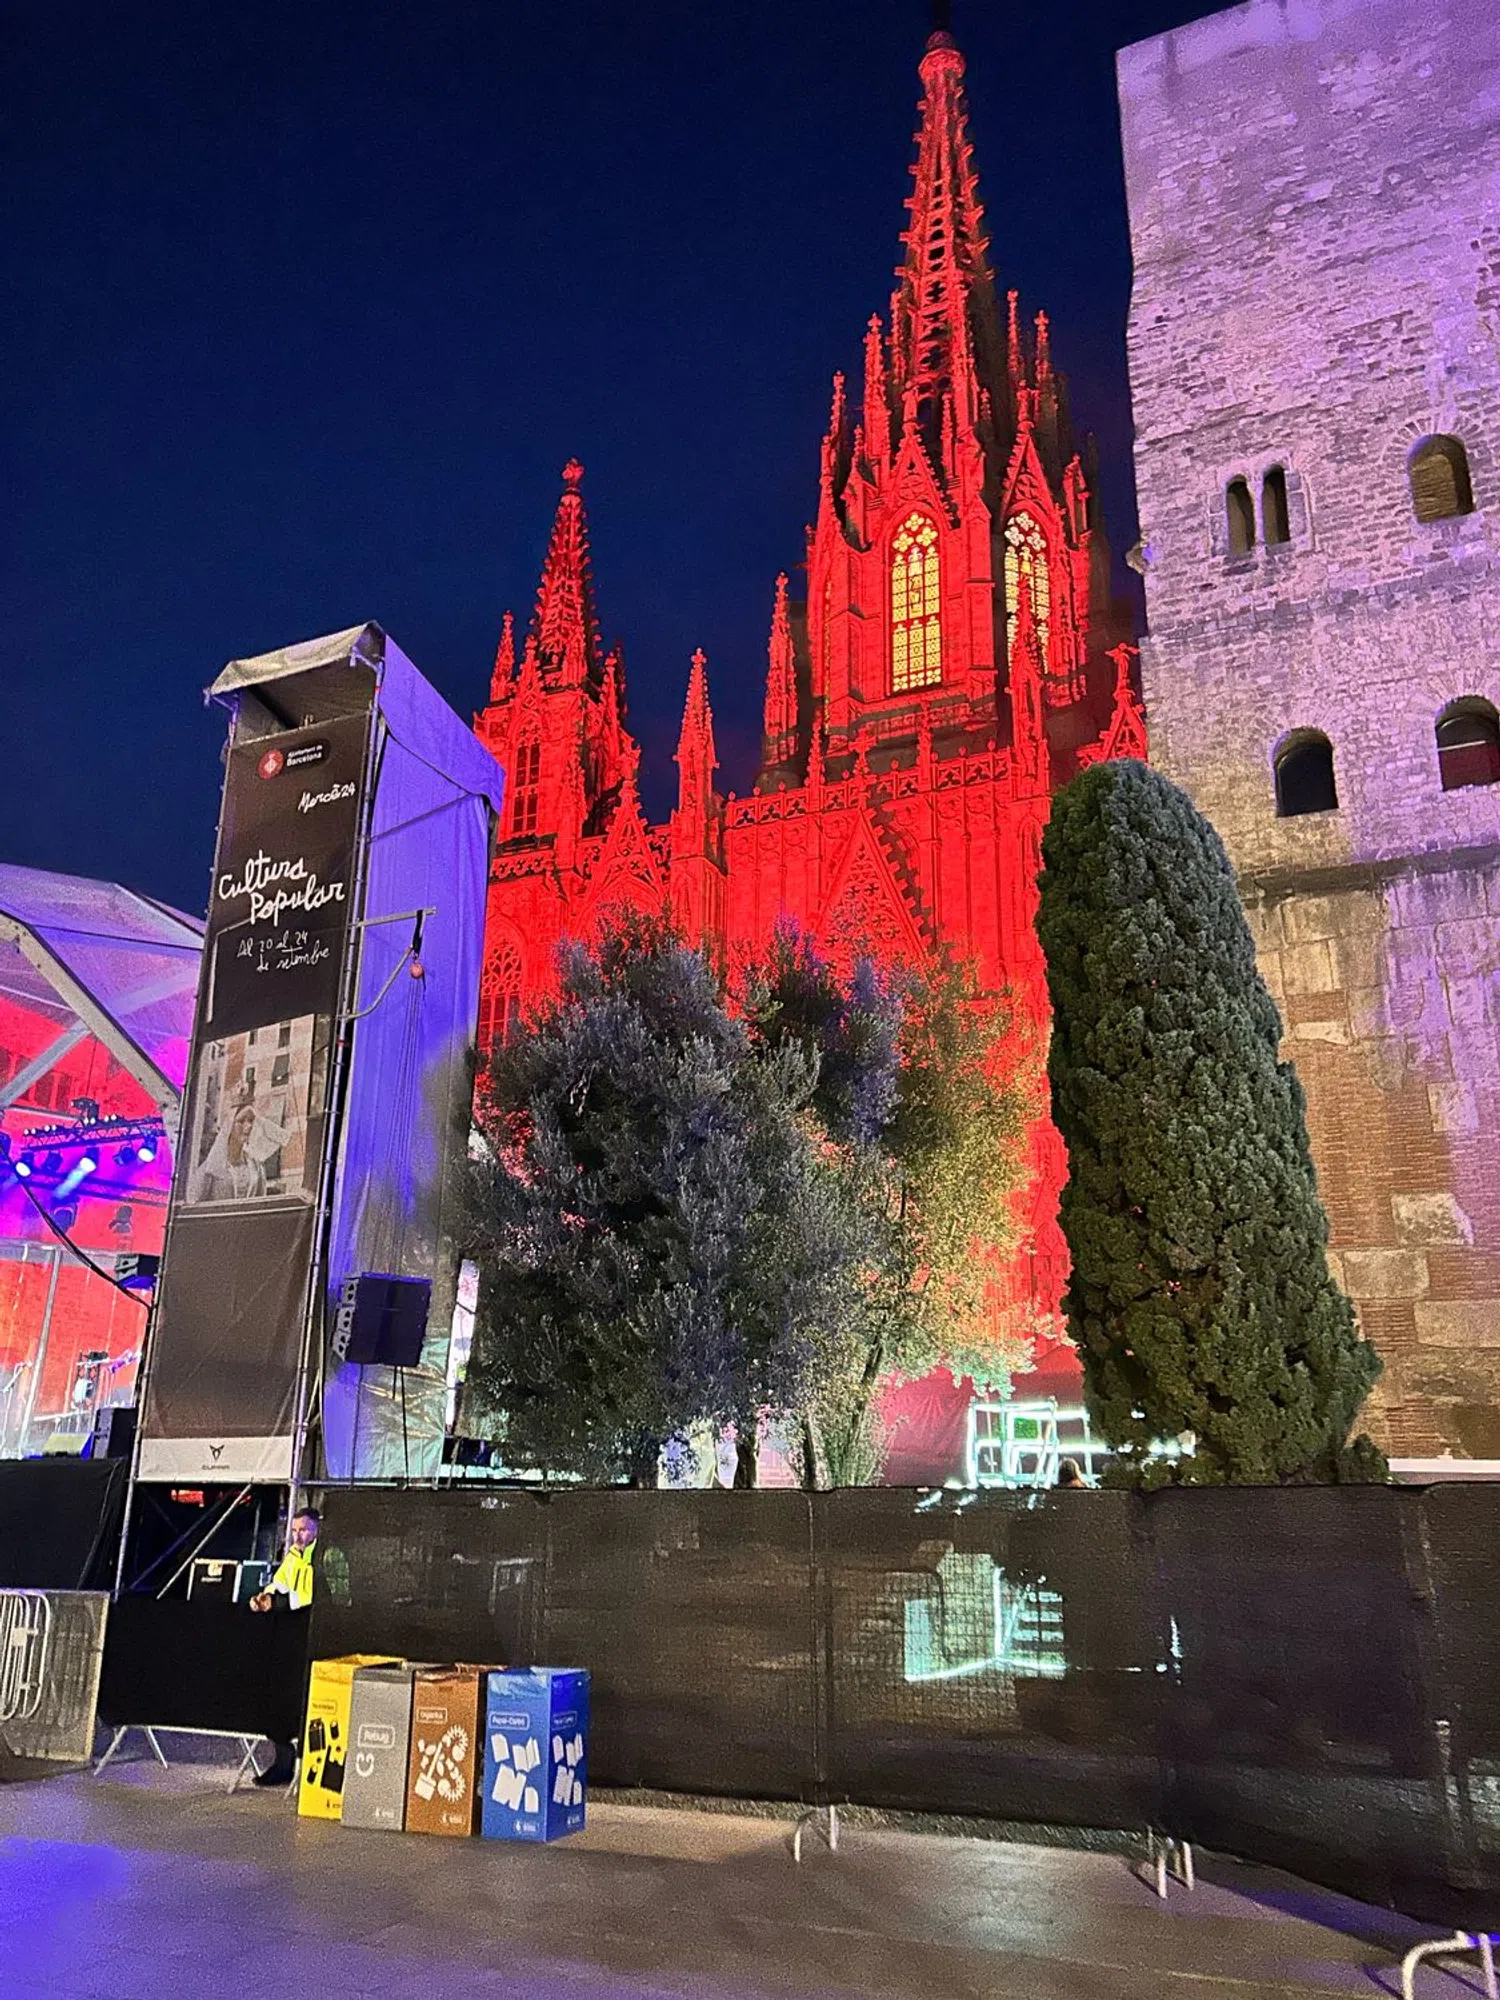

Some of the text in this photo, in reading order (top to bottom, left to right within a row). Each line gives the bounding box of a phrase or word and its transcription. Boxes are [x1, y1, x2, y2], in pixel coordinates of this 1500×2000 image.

[286, 752, 322, 767] Barcelona
[218, 850, 308, 900] Cultura
[250, 874, 345, 927] Popular
[256, 939, 330, 972] de setembre
[260, 938, 273, 953] 20
[276, 929, 289, 949] al
[295, 930, 308, 946] 24
